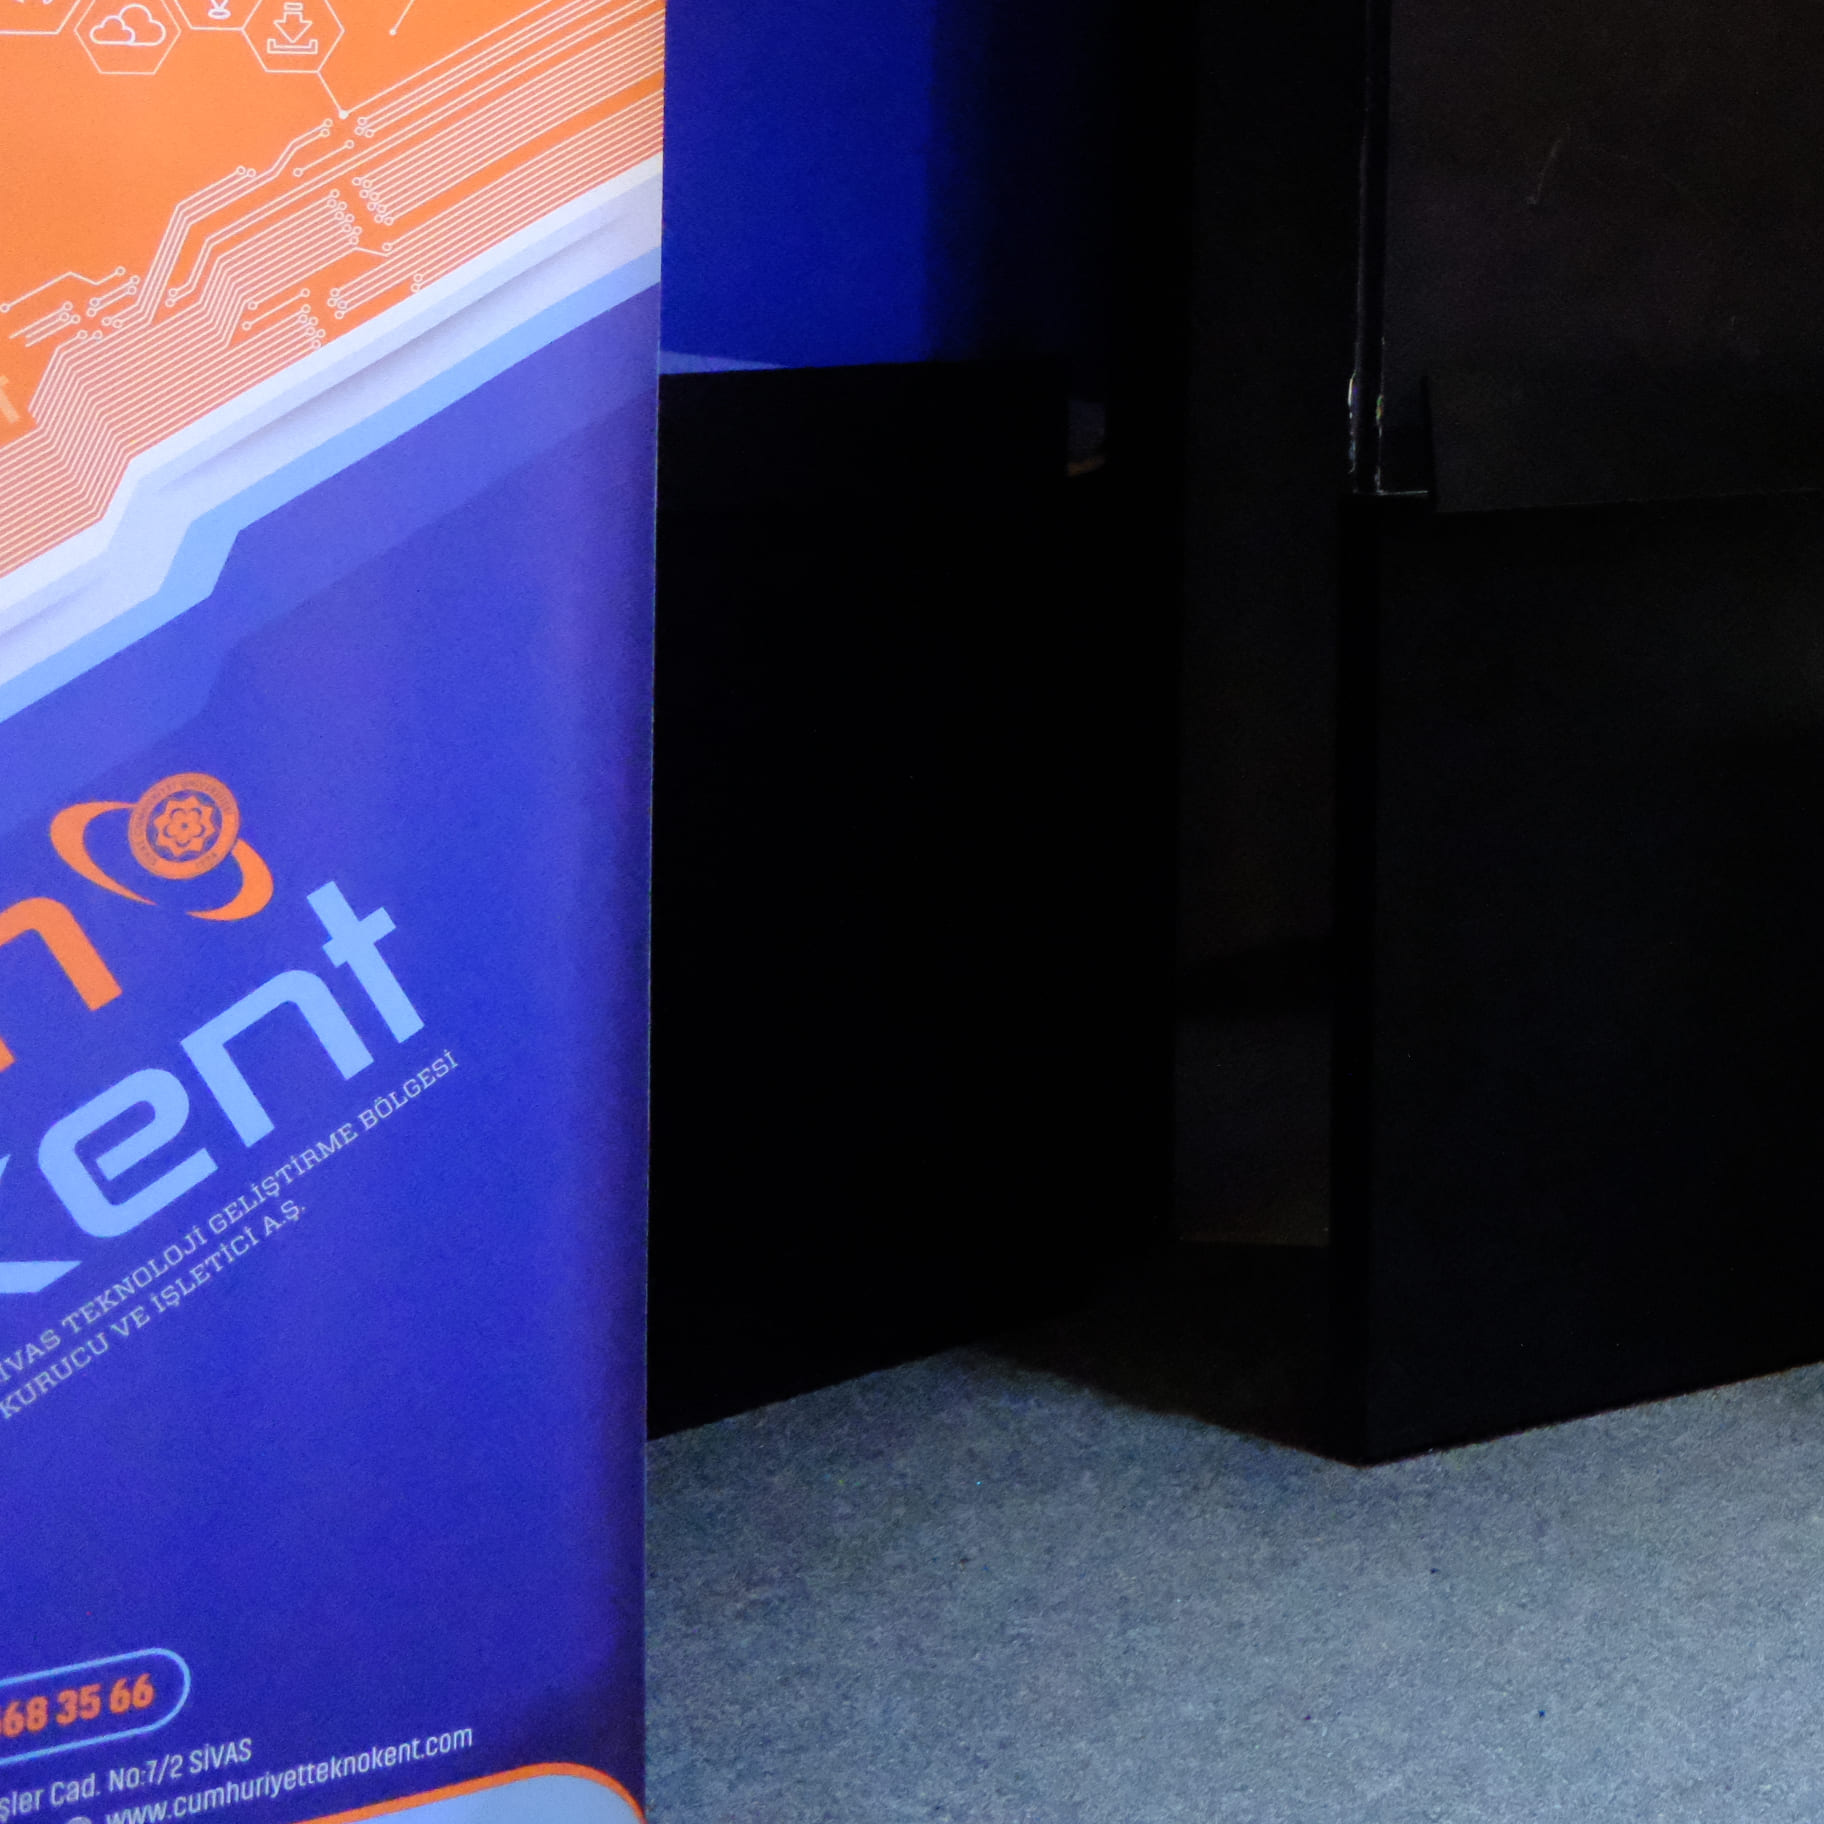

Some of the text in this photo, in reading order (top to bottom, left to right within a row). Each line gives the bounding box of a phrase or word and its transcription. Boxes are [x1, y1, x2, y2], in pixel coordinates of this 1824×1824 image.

[62, 1225, 208, 1334] TEKNOLOJİ
[207, 1123, 358, 1236] GELİŞTİRME
[358, 1049, 458, 1132] BÖLGESİ
[0, 1199, 306, 1419] KURUCU VE İŞLETİCİ A.Ş.
[56, 1684, 101, 1726] 35
[109, 1673, 155, 1714] 66
[50, 1773, 101, 1807] Cad.
[108, 1753, 184, 1793] No:7/2
[189, 1737, 252, 1775] SİVAS
[106, 1727, 473, 1824] www.cumhuriyetteknokent.com
